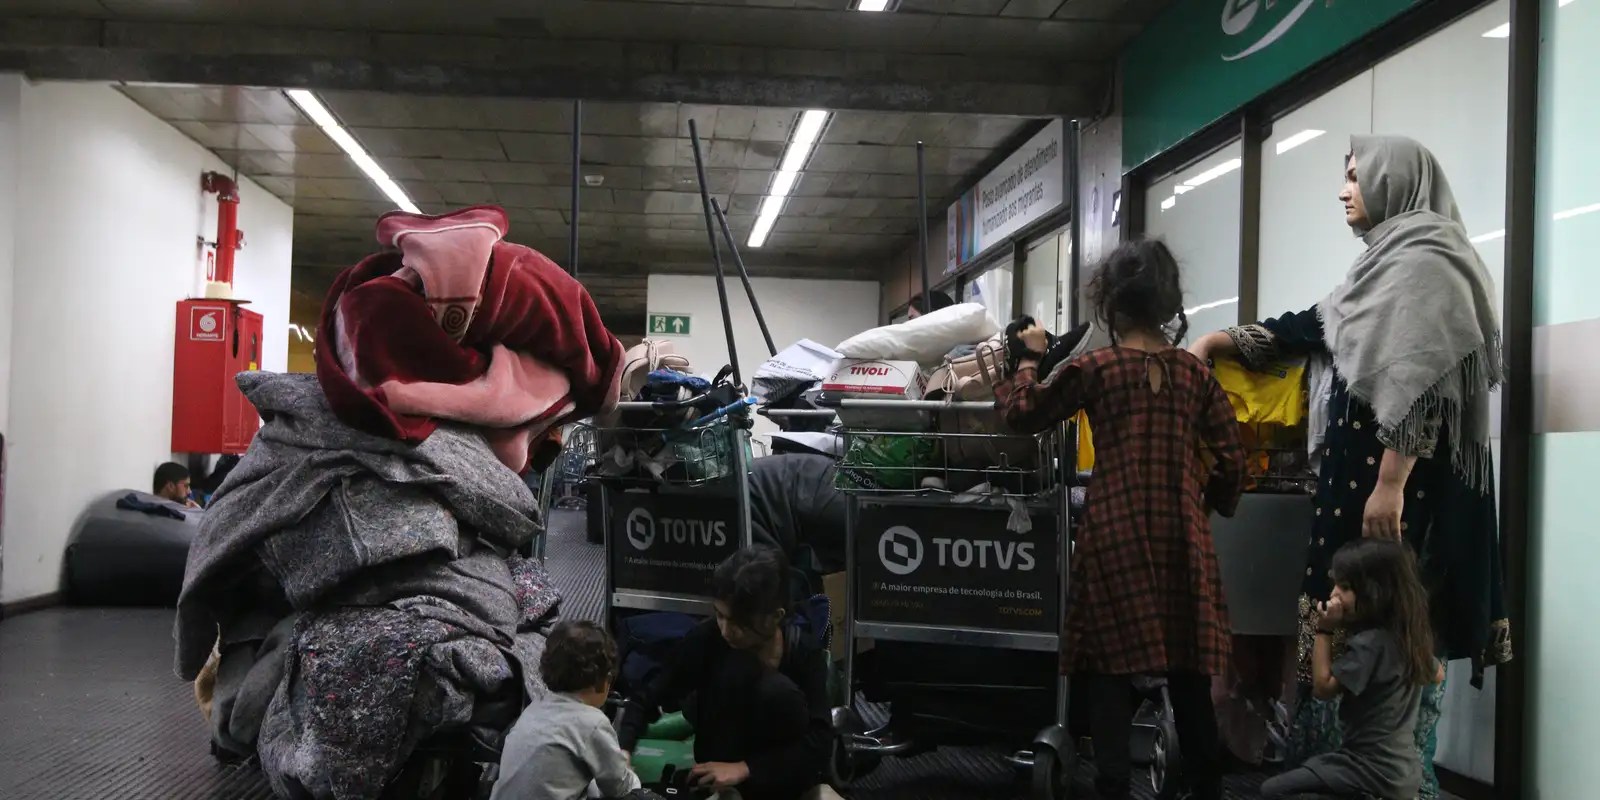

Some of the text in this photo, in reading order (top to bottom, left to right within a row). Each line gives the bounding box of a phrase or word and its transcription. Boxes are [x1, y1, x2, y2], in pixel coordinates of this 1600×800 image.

[1024, 137, 1058, 181] atendimento
[1018, 181, 1044, 216] migrantes
[850, 366, 889, 376] TIVOLI
[660, 518, 727, 547] TOTVS
[932, 537, 1036, 571] TOTVS
[880, 582, 1043, 600] A maior empresa de tecnologia do Brasil.
